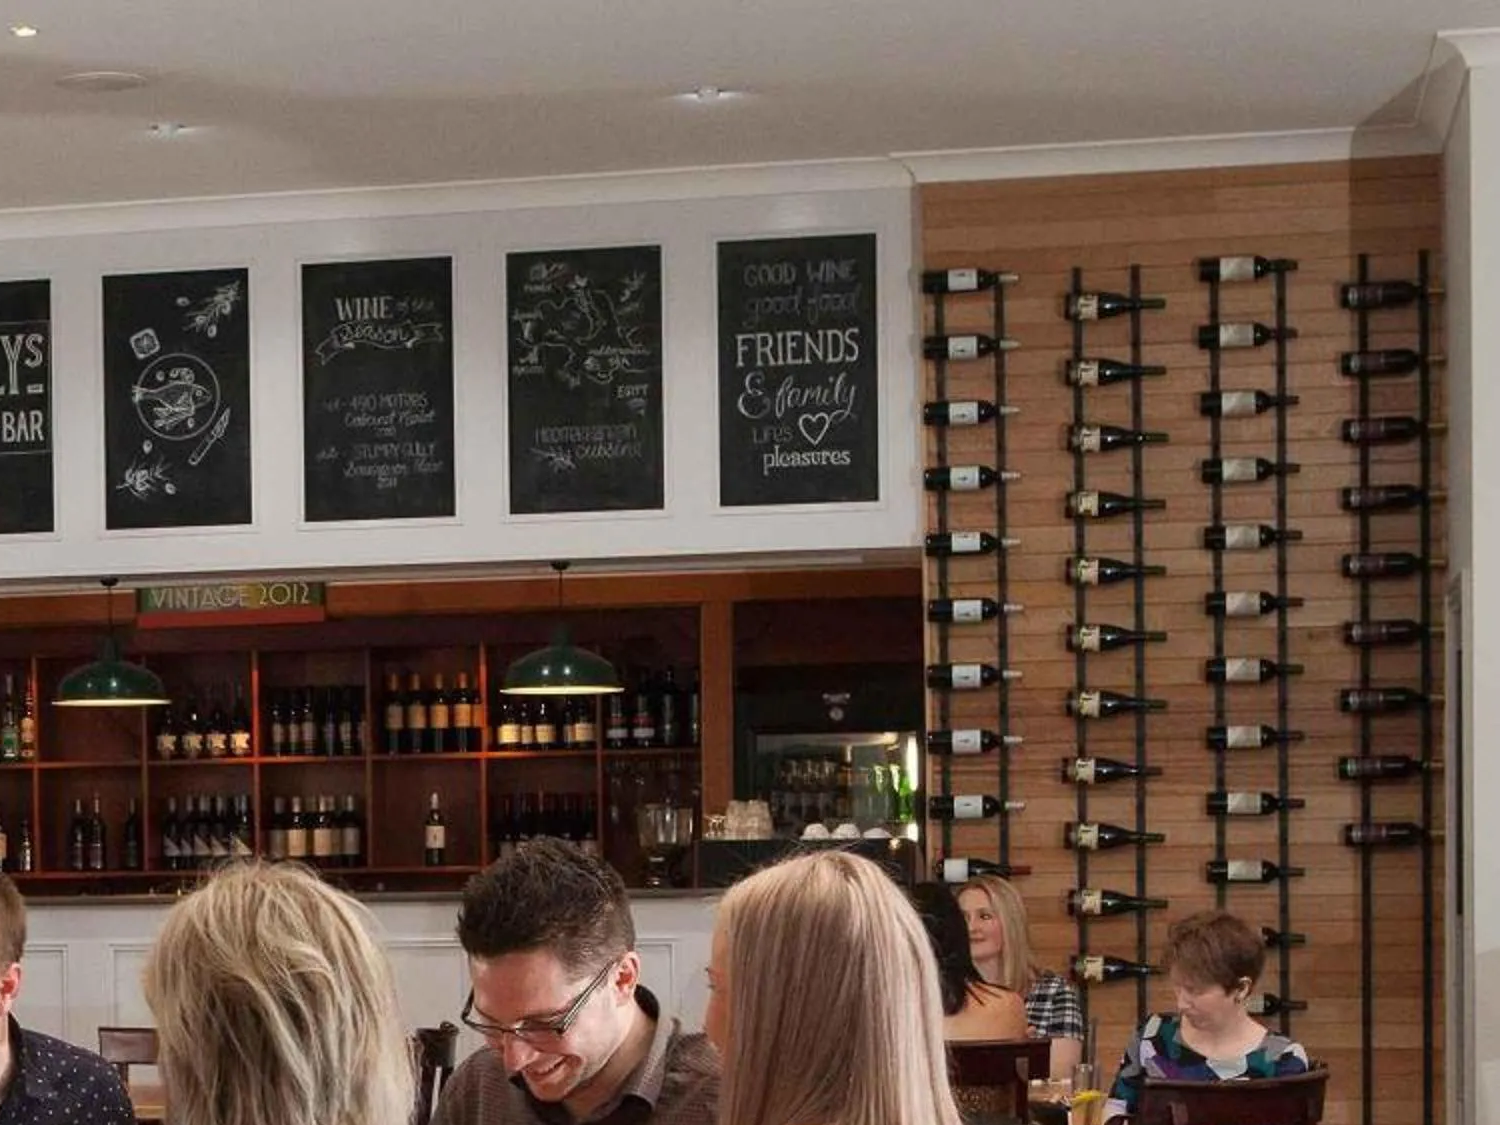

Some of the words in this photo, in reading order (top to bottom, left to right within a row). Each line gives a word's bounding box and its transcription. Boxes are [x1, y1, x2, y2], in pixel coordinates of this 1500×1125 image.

[335, 296, 393, 321] WINE
[734, 328, 860, 367] FRIENDS
[775, 372, 855, 421] family
[763, 445, 851, 476] pleasures
[151, 585, 249, 609] VINTAGE
[259, 582, 310, 606] 2012
